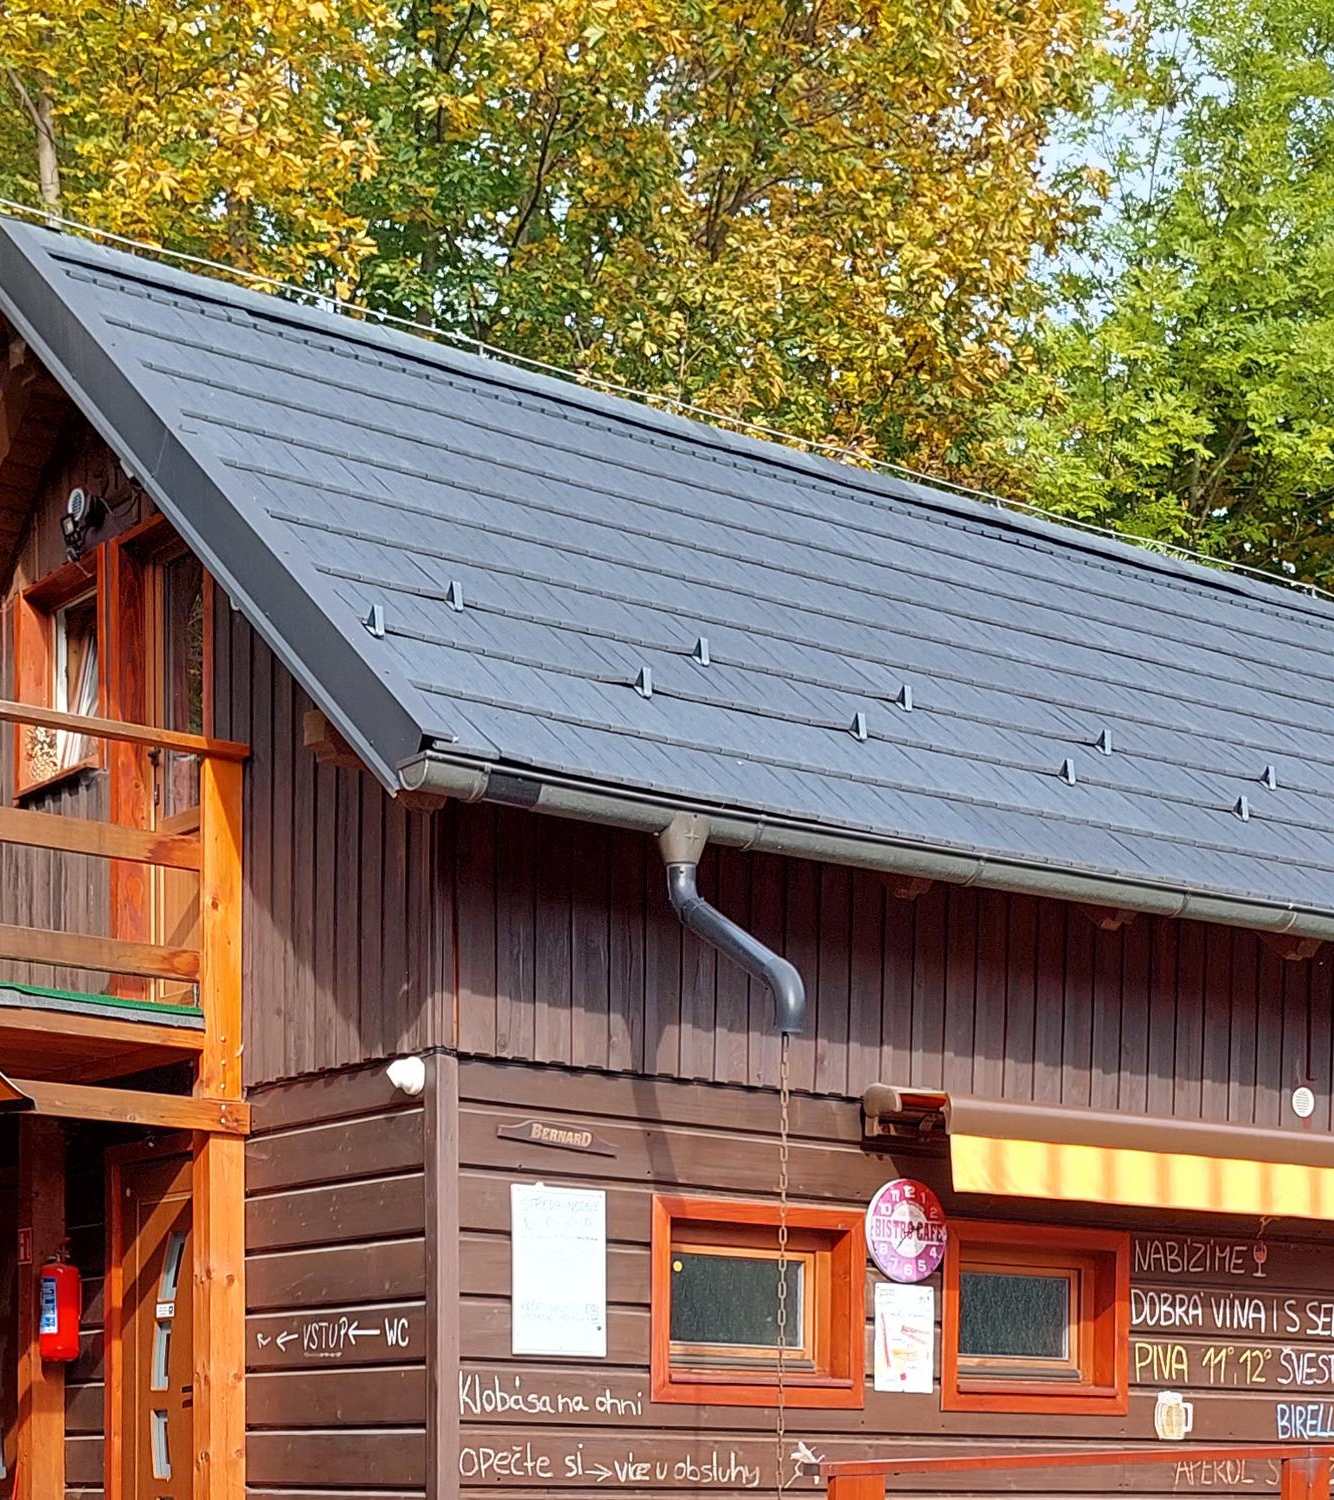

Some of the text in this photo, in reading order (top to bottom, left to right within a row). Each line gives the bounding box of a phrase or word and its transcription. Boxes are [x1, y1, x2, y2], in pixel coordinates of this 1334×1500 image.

[530, 1122, 593, 1148] BERNARD
[875, 1218, 913, 1240] BISTRO
[1130, 1288, 1205, 1327] DOBRÁ
[1211, 1293, 1266, 1333] VÍNA
[1285, 1300, 1301, 1333] S
[302, 1316, 409, 1351] VSTUP WC
[1134, 1342, 1189, 1383] PIVA
[459, 1370, 643, 1416] Klobása na ohni
[564, 1442, 583, 1477] si
[673, 1451, 760, 1488] obsluhy
